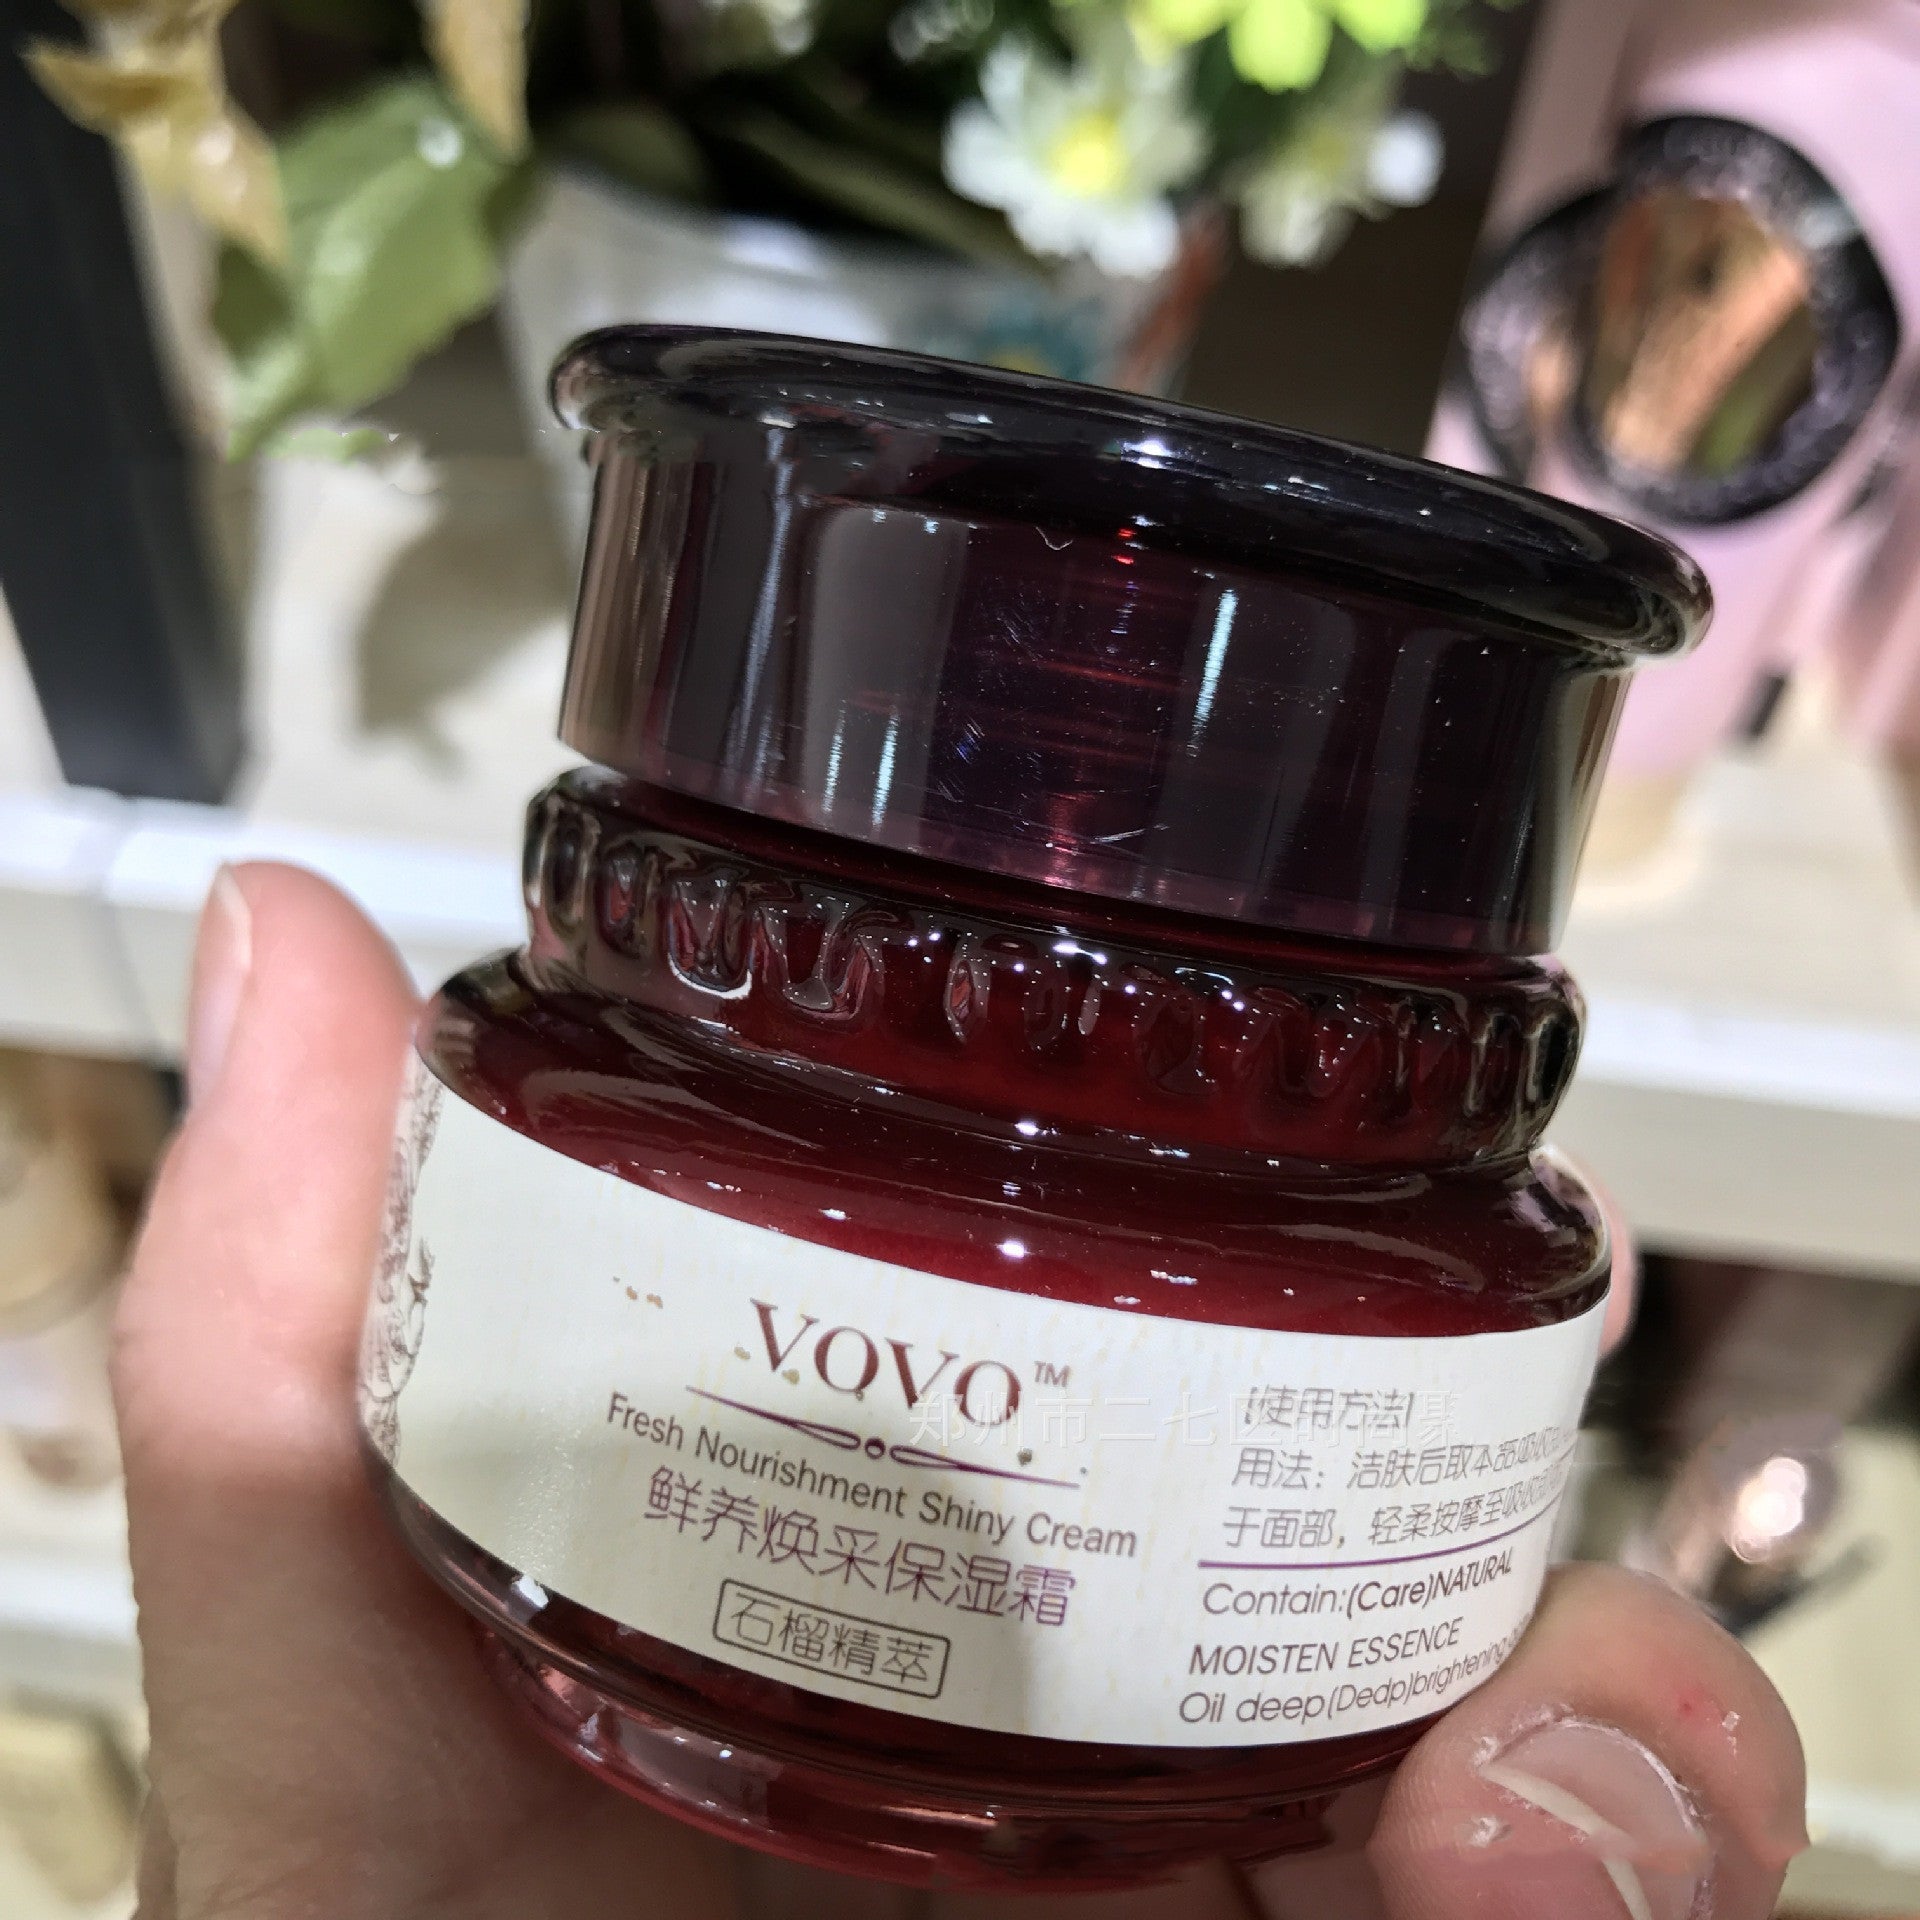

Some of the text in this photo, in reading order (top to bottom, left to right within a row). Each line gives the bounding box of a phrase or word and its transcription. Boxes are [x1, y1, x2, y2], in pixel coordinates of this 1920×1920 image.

[750, 1297, 1022, 1427] VOVO
[606, 1392, 1138, 1558] Fresh Nourishment Shiny Cream
[643, 1464, 1077, 1627] 鲜养焕采保湿霜
[729, 1591, 935, 1683] 石榴精萃
[1188, 1640, 1337, 1676] MOISTEN
[1346, 1615, 1465, 1669] ESSENCE
[1178, 1691, 1226, 1723] Oil
